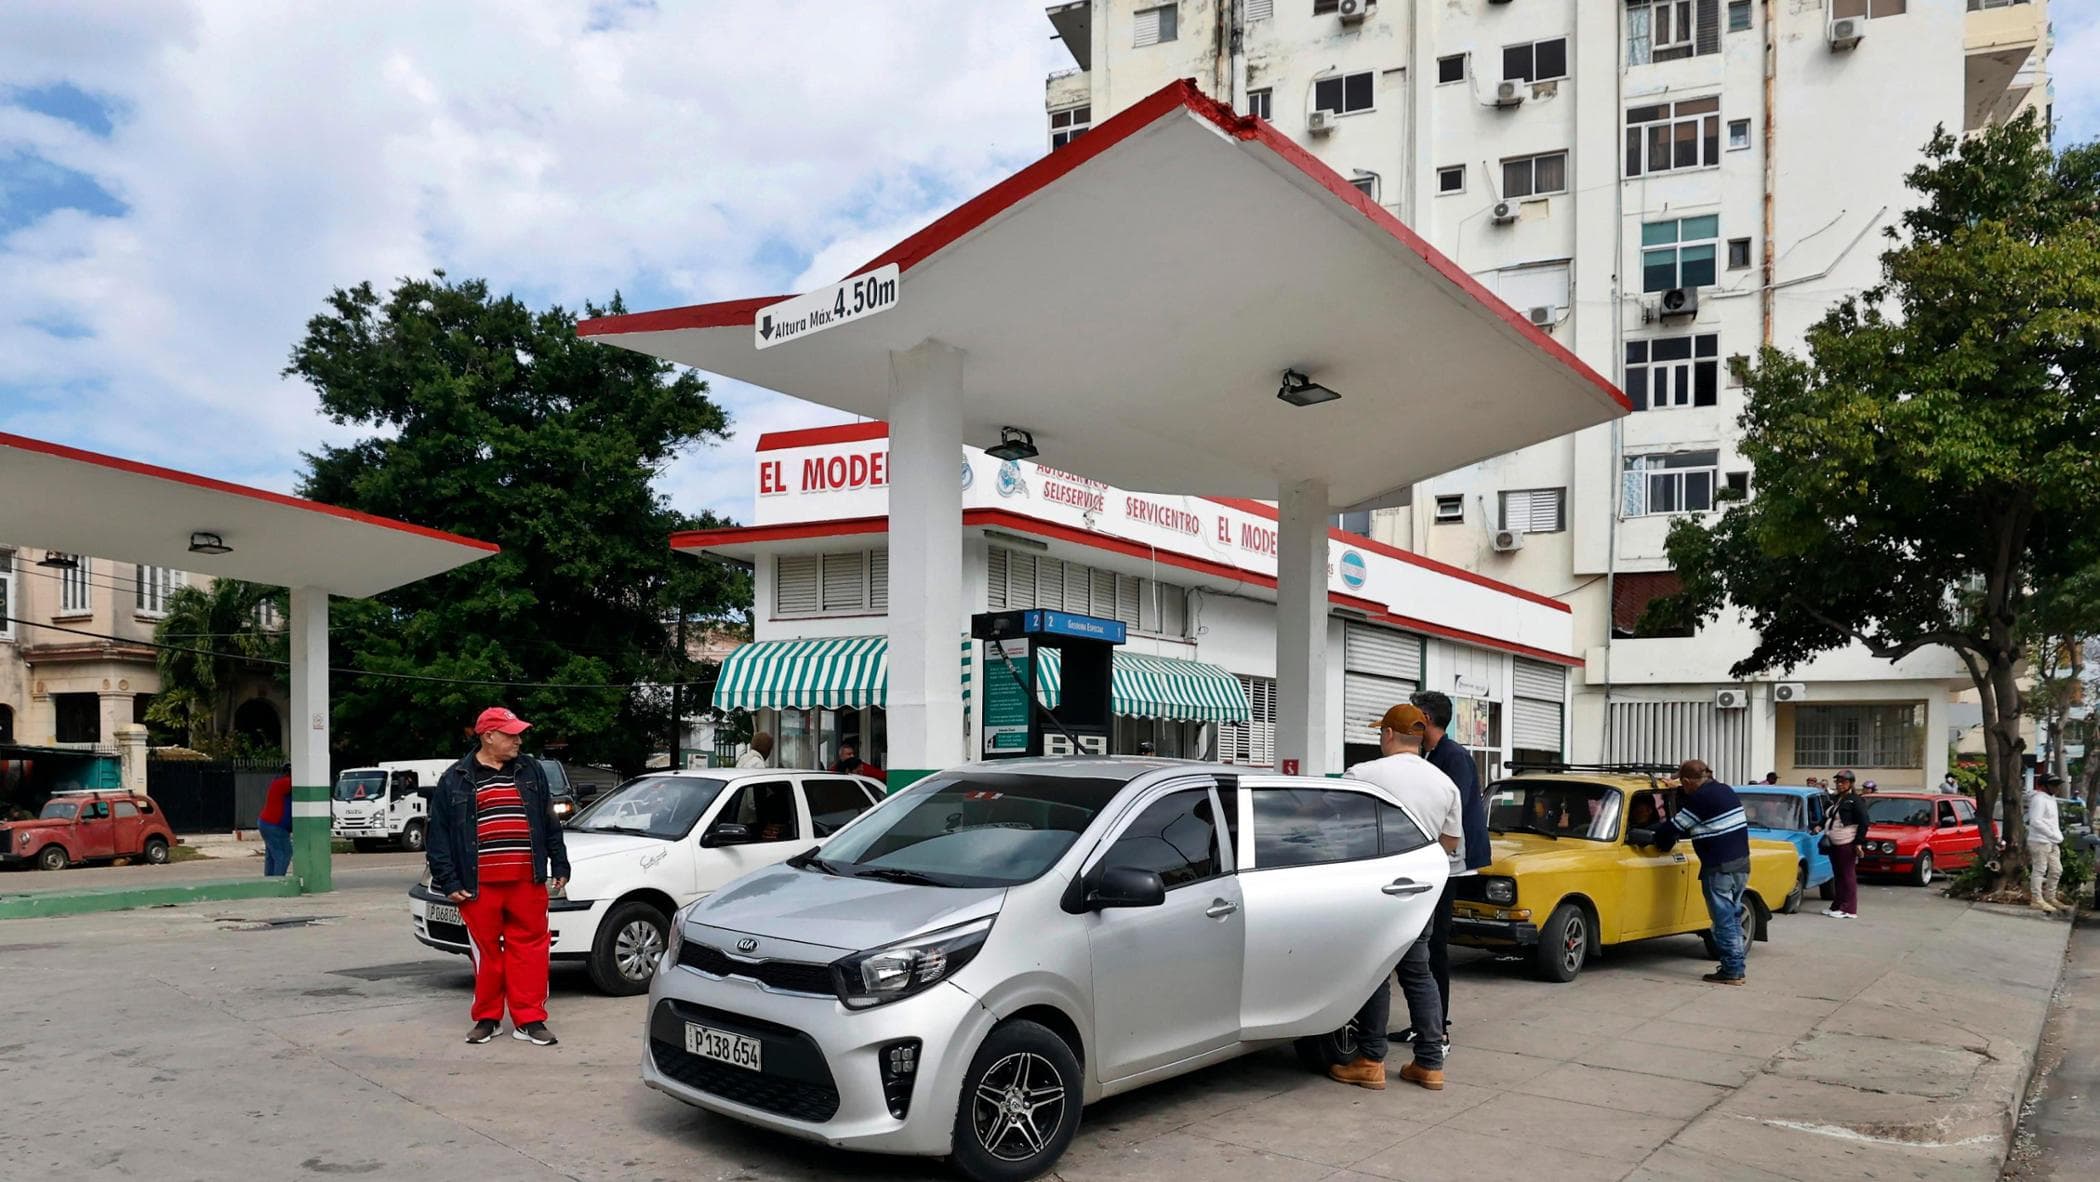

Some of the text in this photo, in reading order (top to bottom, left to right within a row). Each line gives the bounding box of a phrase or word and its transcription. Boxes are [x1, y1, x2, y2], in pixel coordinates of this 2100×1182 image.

[774, 276, 895, 340] Altura Máx. 4.50m
[760, 461, 787, 494] EL
[1043, 481, 1105, 512] SELFSERVICE
[1126, 496, 1199, 534] SERVICENTRO
[1218, 516, 1231, 543] EL
[1033, 615, 1039, 626] 2
[1048, 616, 1054, 627] 2
[738, 940, 755, 949] KIA
